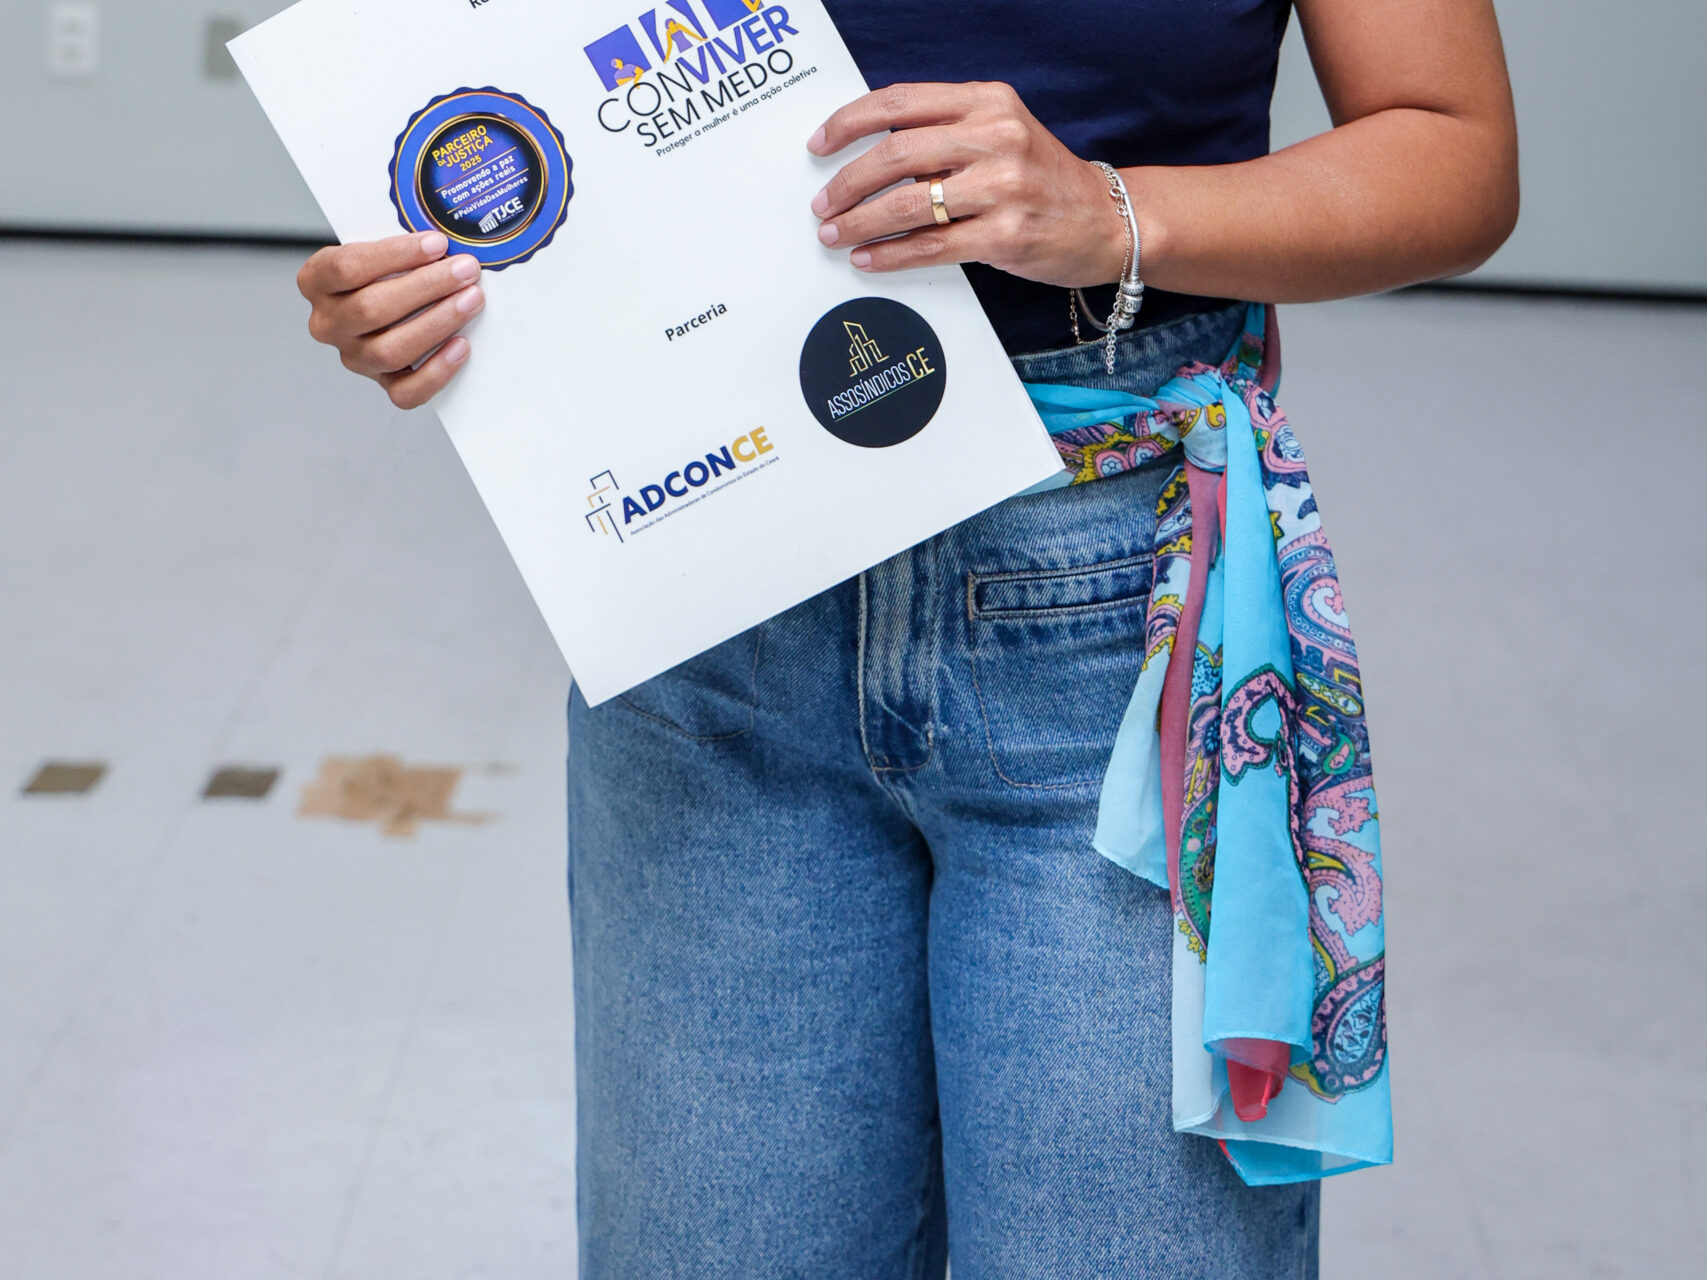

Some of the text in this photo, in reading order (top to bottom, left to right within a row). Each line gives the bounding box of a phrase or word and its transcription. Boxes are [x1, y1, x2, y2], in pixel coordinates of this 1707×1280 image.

[597, 5, 799, 132] CONVIVER
[637, 49, 793, 147] SEM MEDO
[656, 133, 692, 157] Proteger
[702, 112, 731, 133] mulher
[732, 107, 739, 116] é
[739, 98, 759, 112] uma
[760, 86, 782, 100] ação
[783, 65, 818, 88] coletiva
[432, 124, 487, 160] PARCEIRO
[437, 136, 494, 167] DA JUSTIÇA
[460, 155, 482, 171] 2025
[441, 168, 491, 199] Promovendo
[499, 155, 515, 169] paz
[453, 165, 516, 204] com ações reais
[453, 176, 528, 220] #PelaVidaDasMulheres
[491, 196, 524, 220] TJCE
[664, 303, 727, 341] Parceria
[827, 346, 935, 419] ASSOSÍNDICOS CE
[622, 426, 774, 524] ADCONCE
